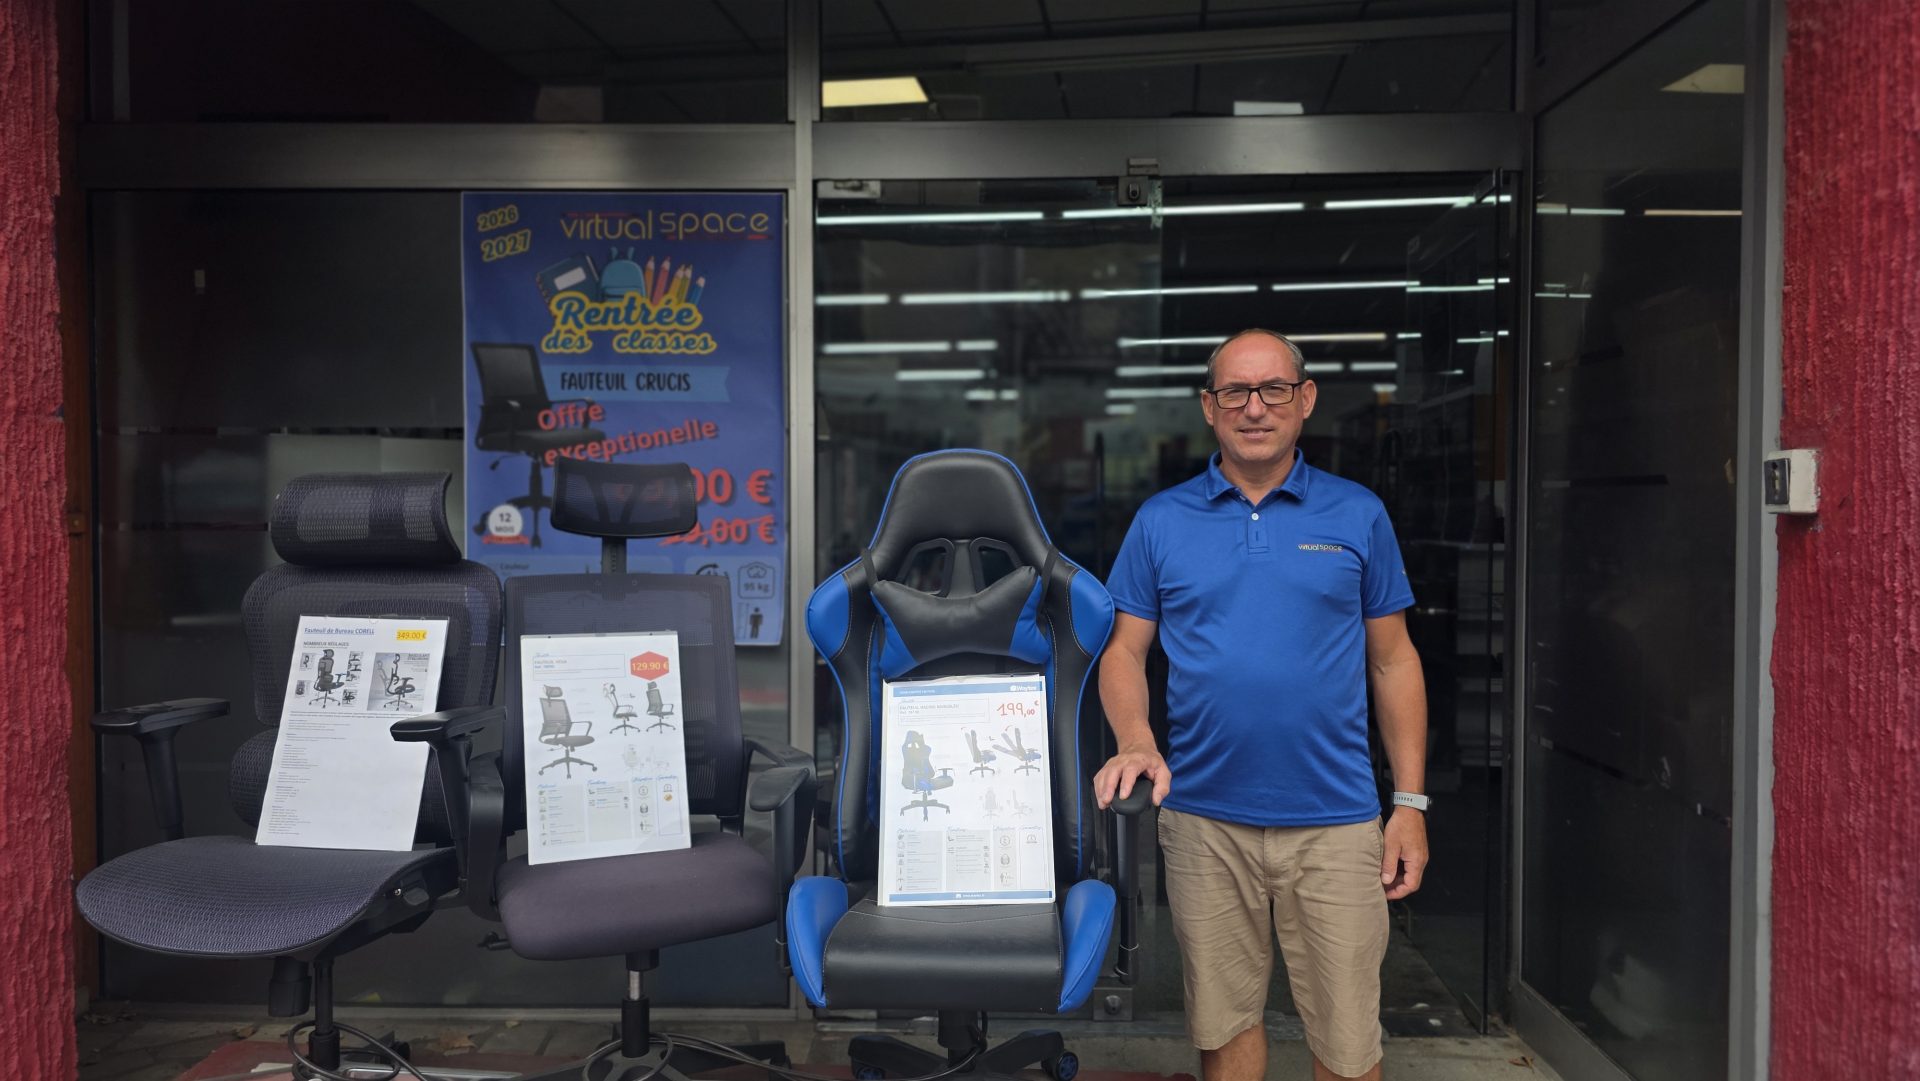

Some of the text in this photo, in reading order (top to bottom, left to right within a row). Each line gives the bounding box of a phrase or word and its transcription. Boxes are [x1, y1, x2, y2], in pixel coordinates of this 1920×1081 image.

[477, 206, 518, 231] 2026
[560, 209, 769, 240] virtual space
[481, 230, 532, 262] 2027
[553, 293, 701, 330] Rentrée
[544, 328, 717, 353] des classes
[560, 371, 691, 392] FAUTEUIL CRUCIS
[537, 402, 605, 431] Offre
[544, 418, 717, 465] exceptionelle
[746, 468, 772, 504] €
[499, 512, 511, 523] 12
[757, 515, 775, 544] €
[632, 662, 661, 671] 129.90
